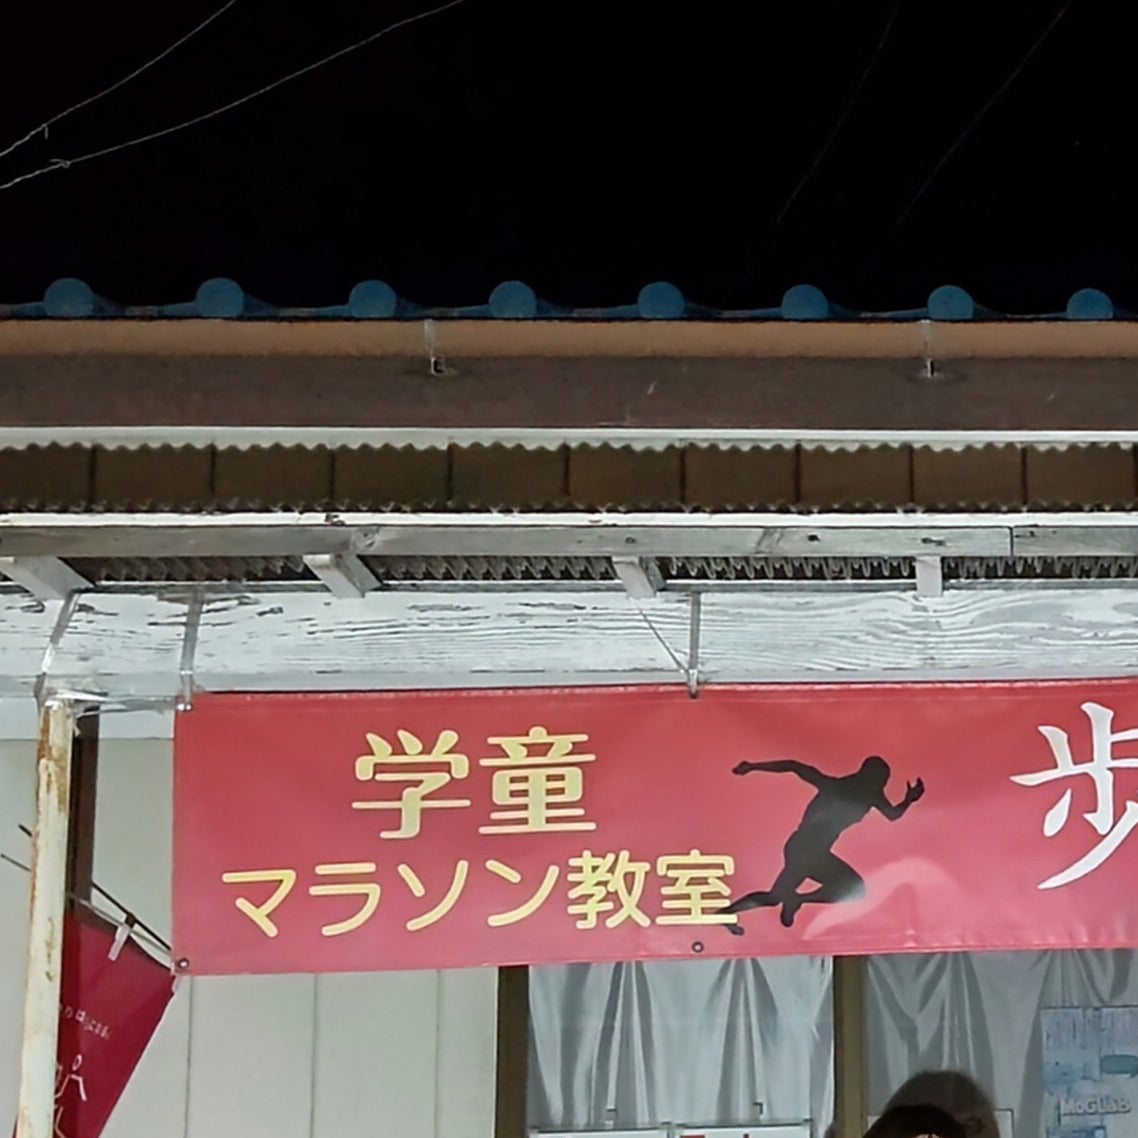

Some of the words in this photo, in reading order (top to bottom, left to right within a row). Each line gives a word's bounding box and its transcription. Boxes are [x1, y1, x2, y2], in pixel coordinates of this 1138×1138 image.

[351, 726, 596, 839] 学童
[222, 849, 739, 937] マラソン教室
